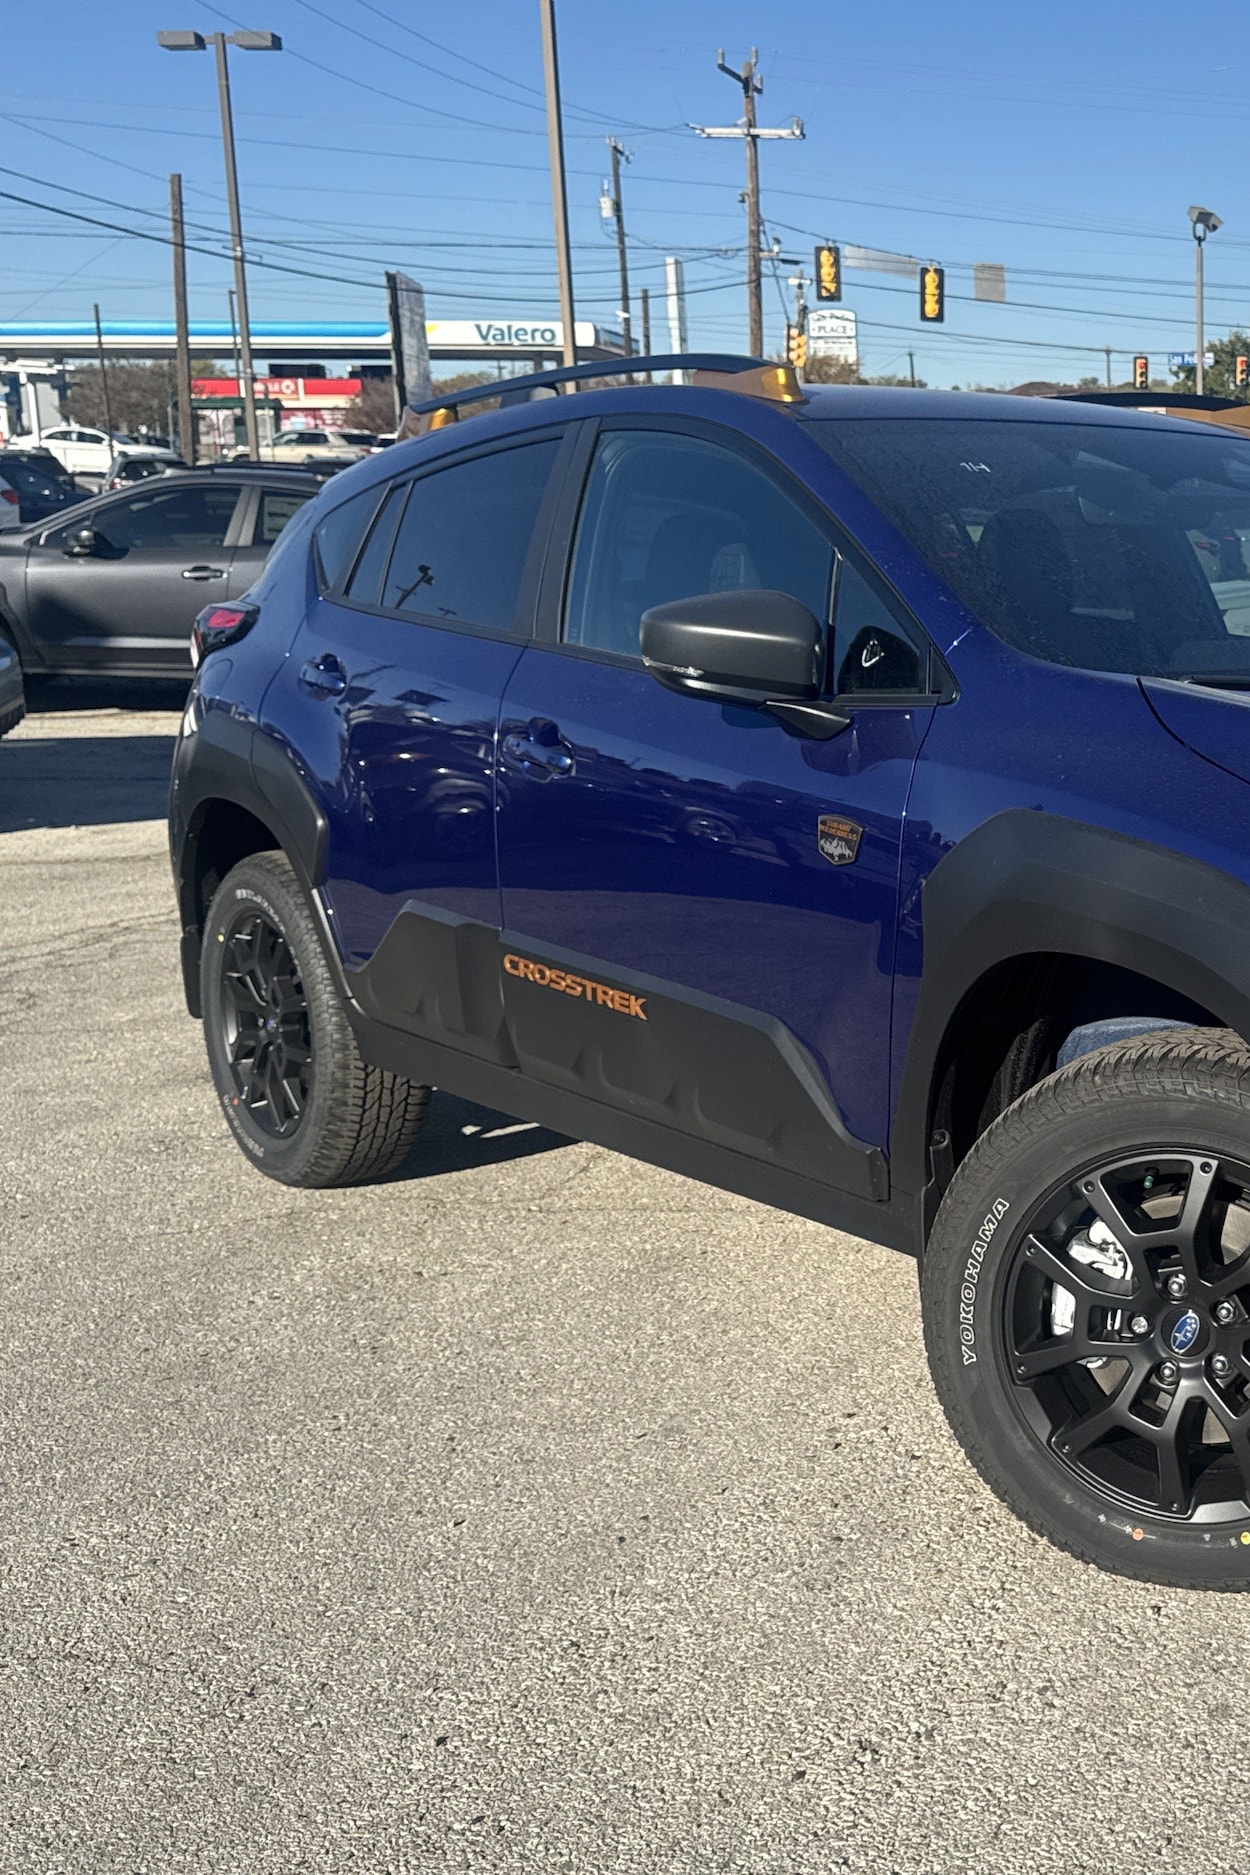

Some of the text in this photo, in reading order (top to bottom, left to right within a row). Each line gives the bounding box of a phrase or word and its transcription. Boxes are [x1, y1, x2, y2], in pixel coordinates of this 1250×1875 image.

[474, 323, 556, 343] Valero
[817, 325, 848, 334] PLACE
[502, 953, 648, 1021] CROSSTREK
[962, 1198, 1011, 1365] YOKOHAMA
